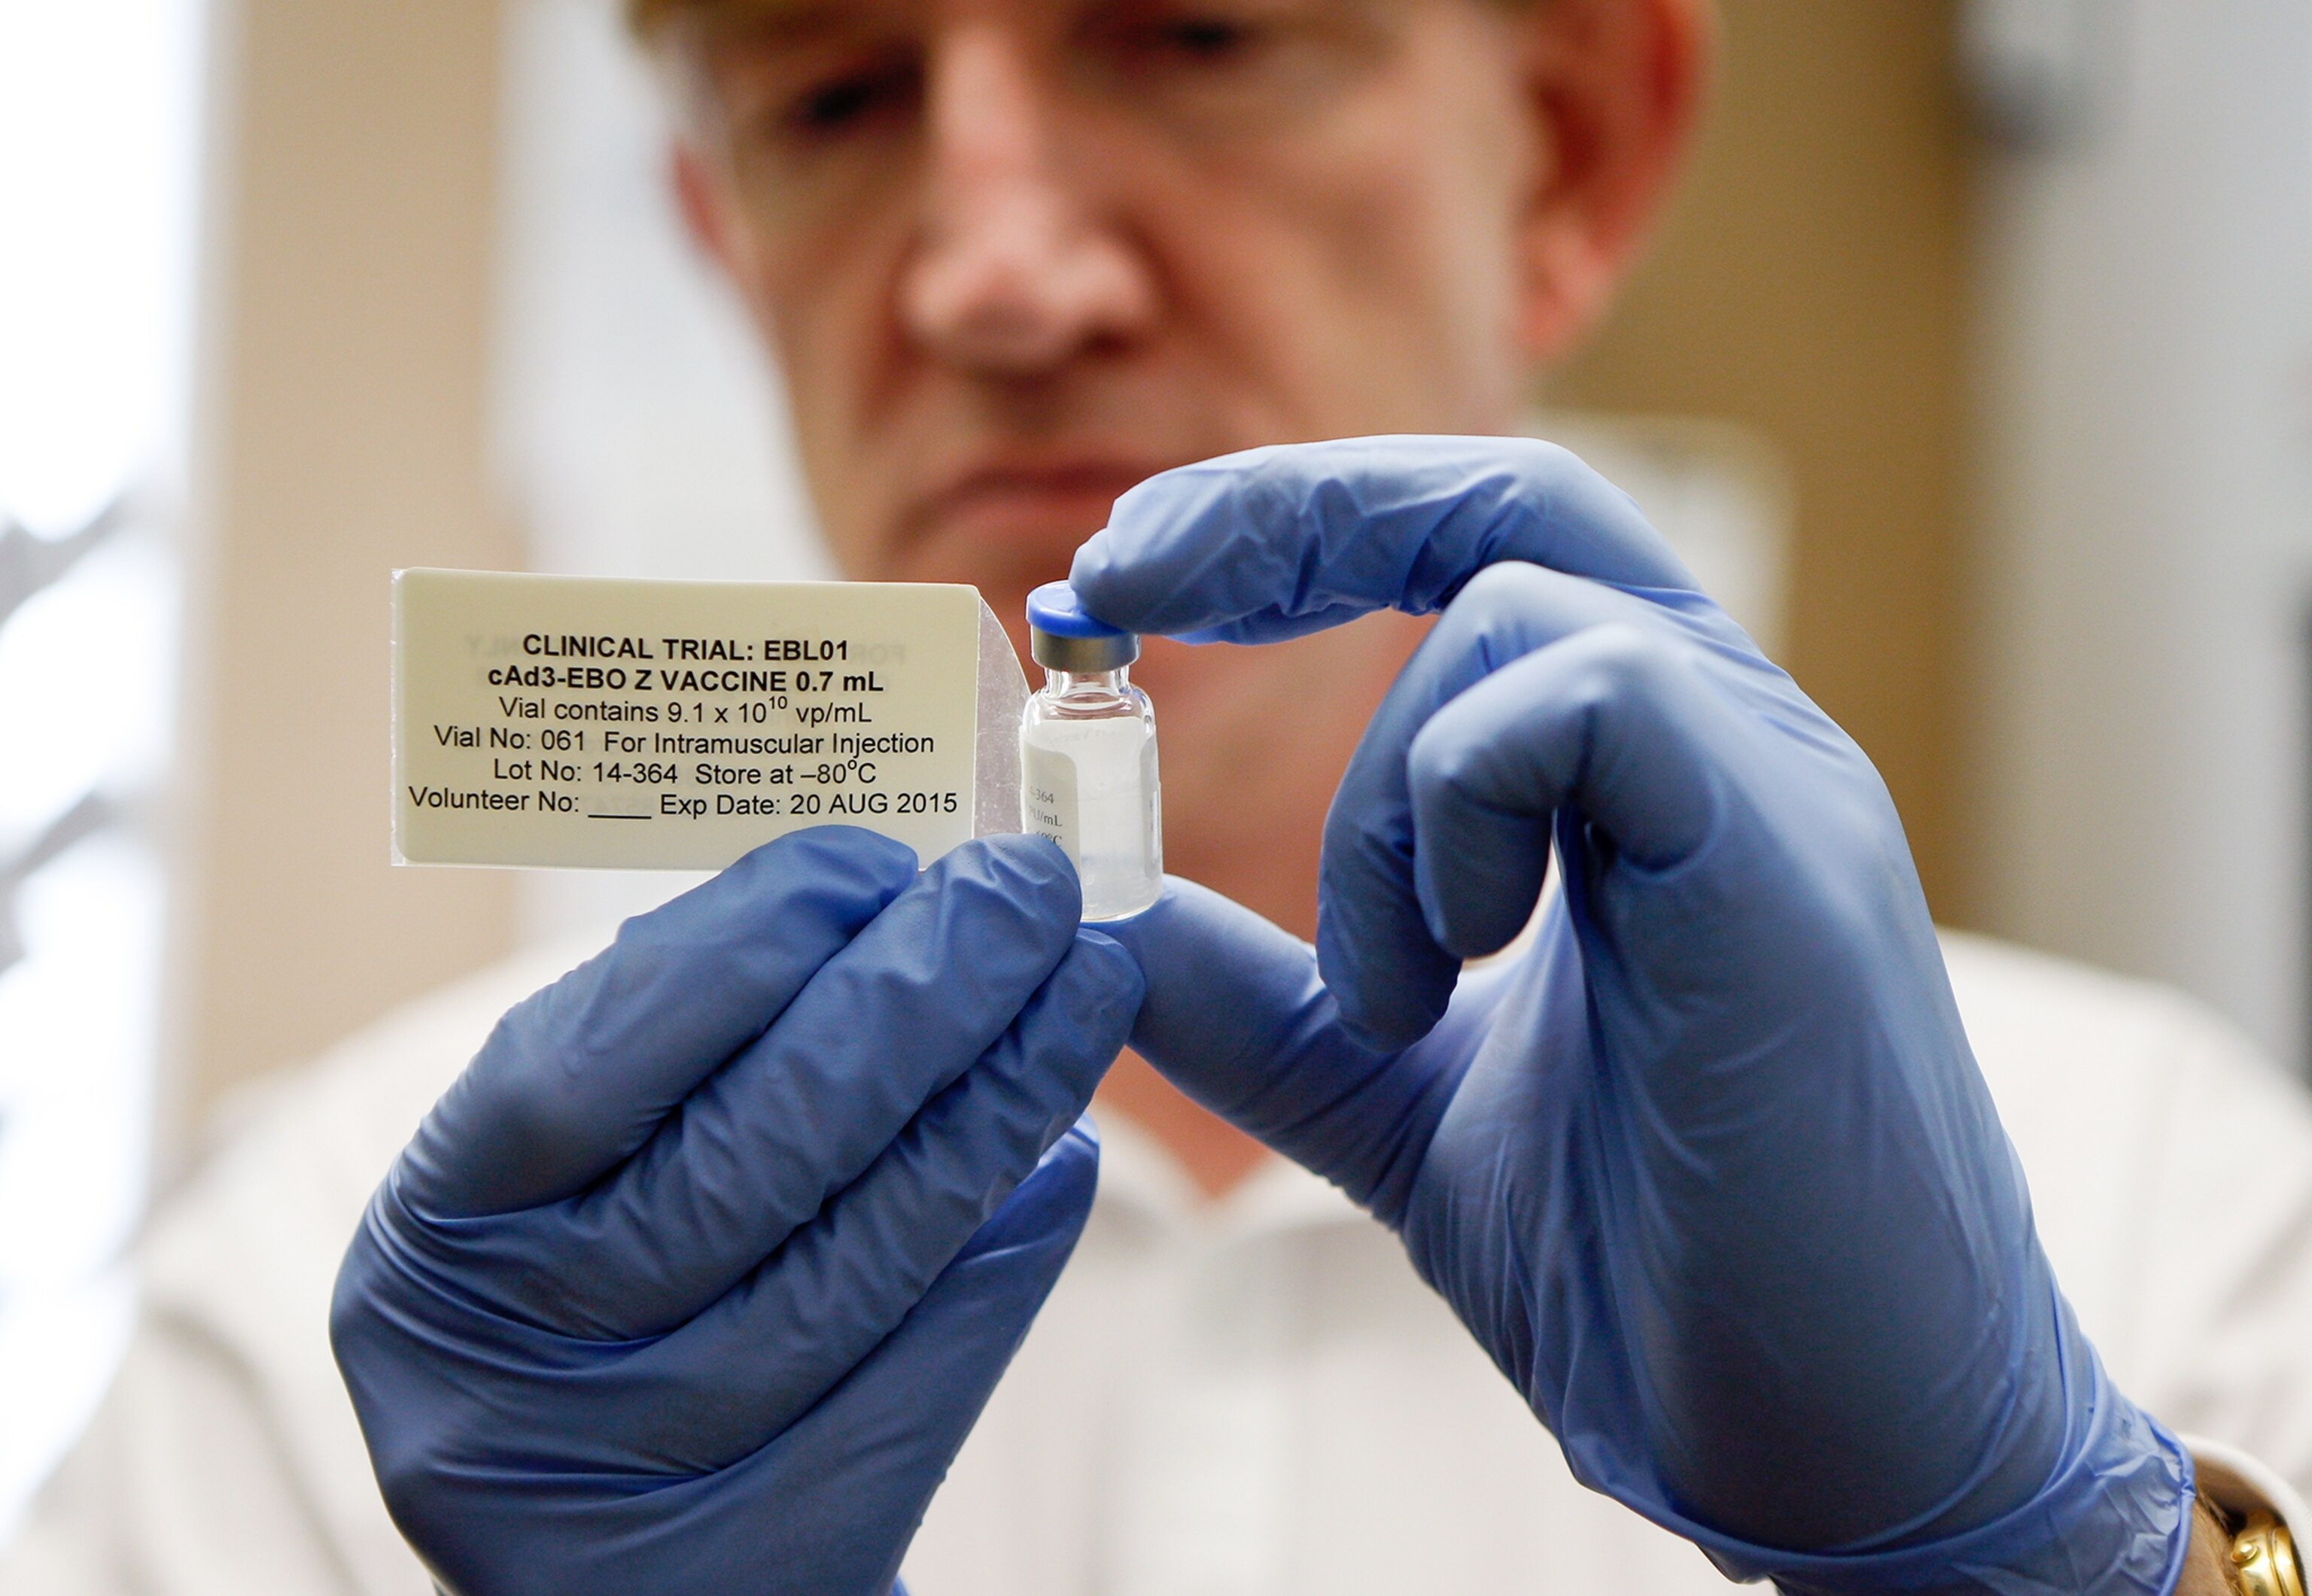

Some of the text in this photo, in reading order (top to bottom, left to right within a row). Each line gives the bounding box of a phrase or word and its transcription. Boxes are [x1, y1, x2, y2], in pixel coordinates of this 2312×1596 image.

[522, 634, 847, 661] CLINICAL TRIAL: EBL01
[488, 664, 884, 692] cAd3-EBO Z VACCINE 0.7 mL
[498, 696, 546, 719] Vial
[554, 700, 659, 722] contains
[668, 701, 702, 723] 9.1
[713, 707, 729, 723] x
[796, 701, 872, 728] vp/mL
[434, 725, 934, 759] Vial No: 061 For Intramuscular Injection
[494, 758, 533, 781] Lot
[540, 759, 582, 782] No:
[593, 762, 678, 784] 14-364
[695, 763, 762, 785] Store
[769, 764, 794, 785] at
[408, 786, 957, 820] Volunteer No: Exp Date: 20 AUG 2015
